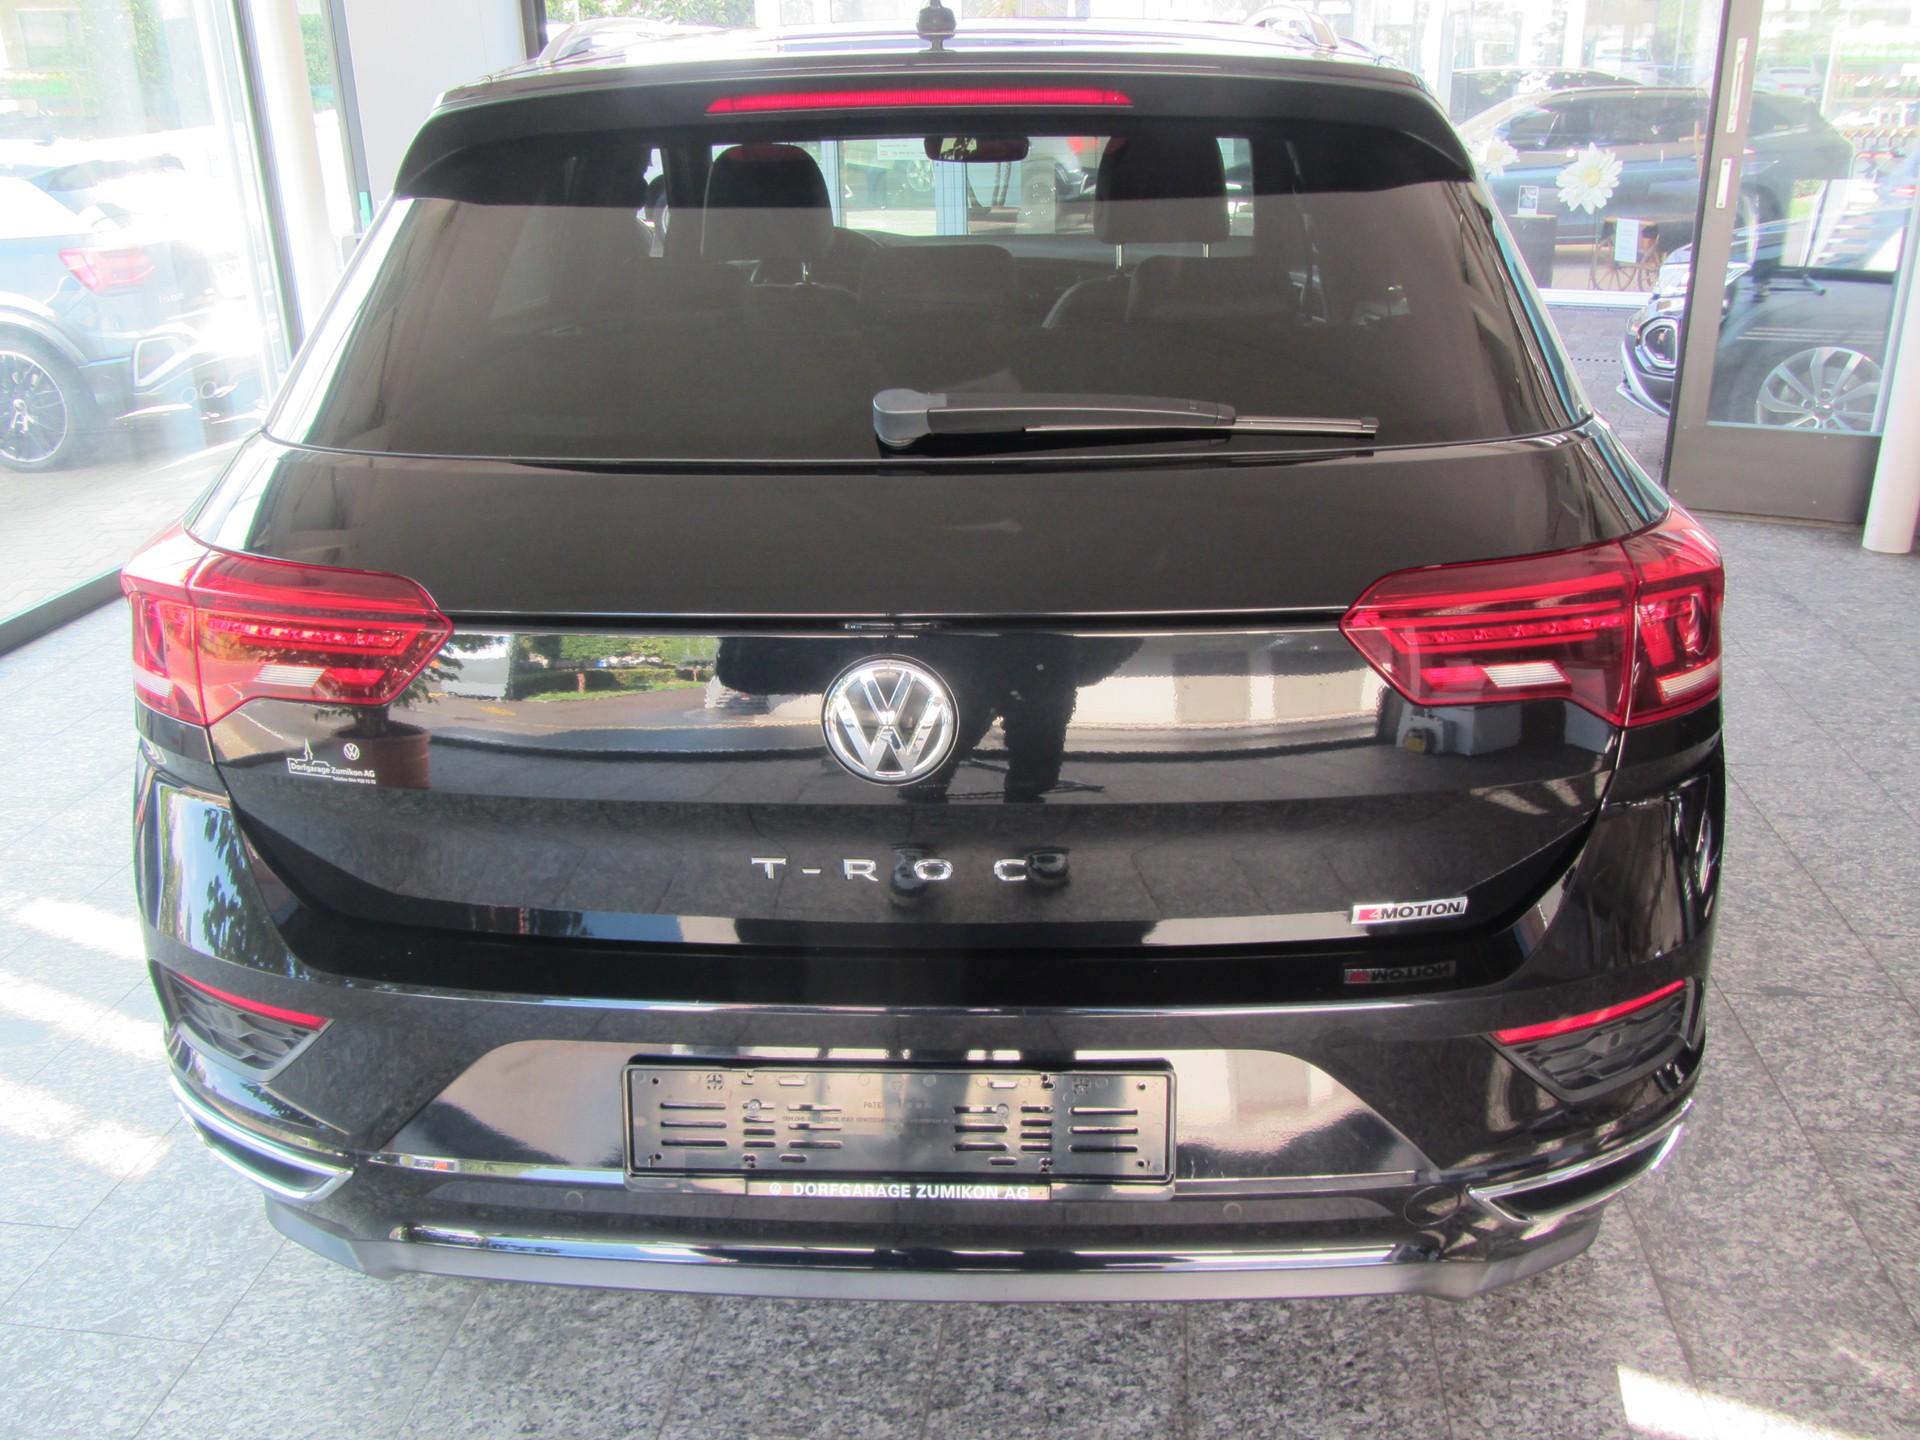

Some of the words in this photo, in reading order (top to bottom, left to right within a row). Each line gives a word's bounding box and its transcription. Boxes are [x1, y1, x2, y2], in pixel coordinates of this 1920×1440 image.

[291, 762, 330, 774] Dorfgarage
[331, 767, 363, 776] Zumikon
[363, 769, 376, 778] AG
[792, 1183, 911, 1198] DORFGARAGE
[916, 1184, 1000, 1199] ZUMIKON
[1004, 1186, 1029, 1199] AG
